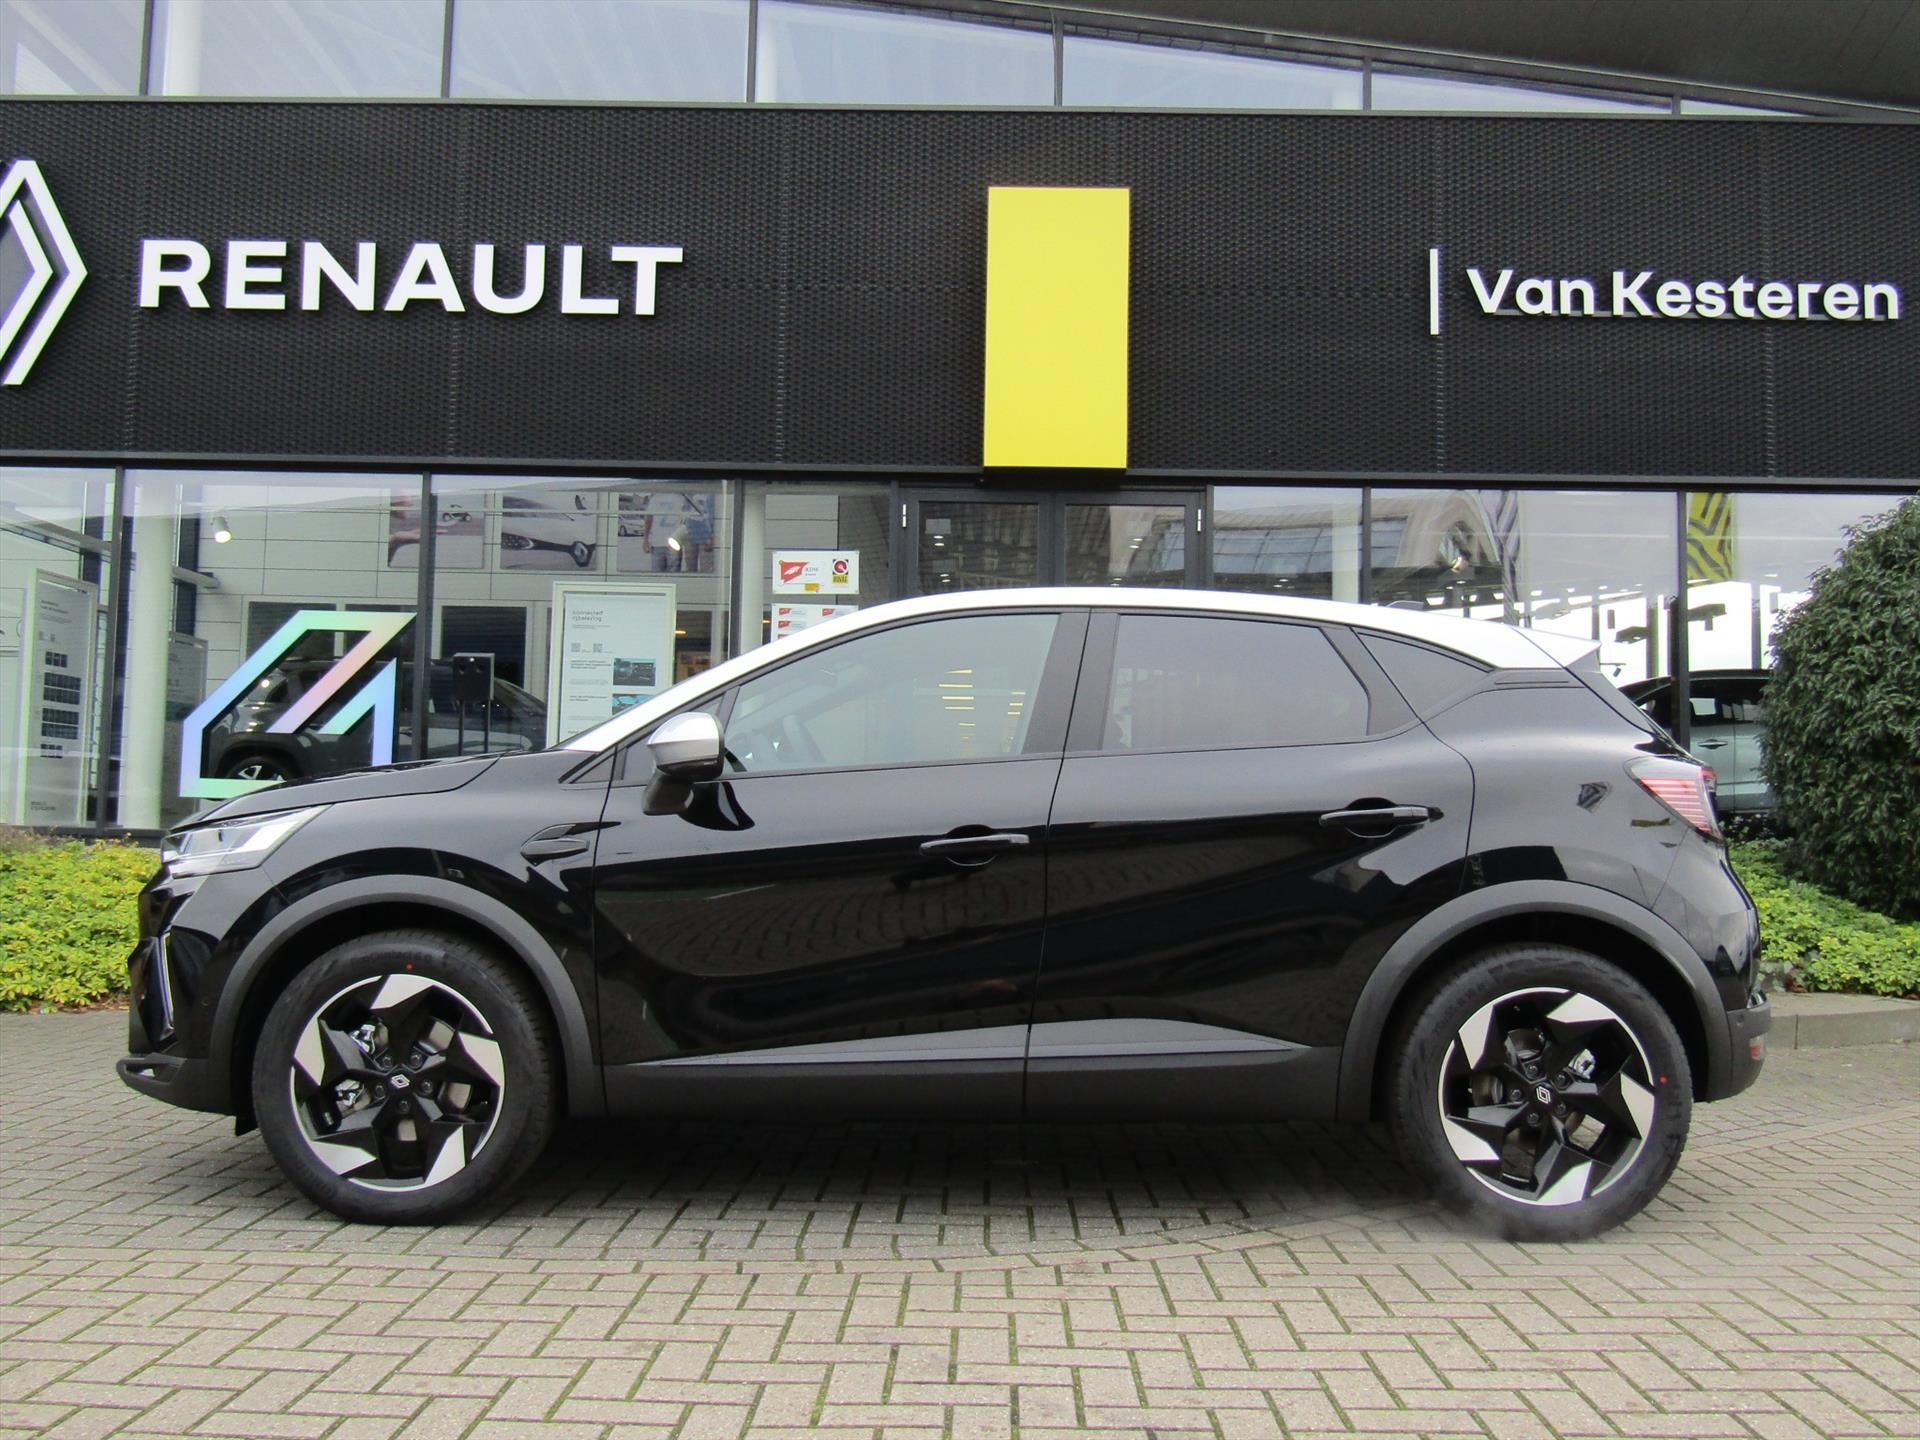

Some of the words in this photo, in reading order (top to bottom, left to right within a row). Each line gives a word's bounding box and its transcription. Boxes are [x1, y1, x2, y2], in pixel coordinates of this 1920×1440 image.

[140, 240, 683, 315] RENAULT
[1467, 269, 1594, 314] Van
[1613, 272, 1898, 319] Kesteren
